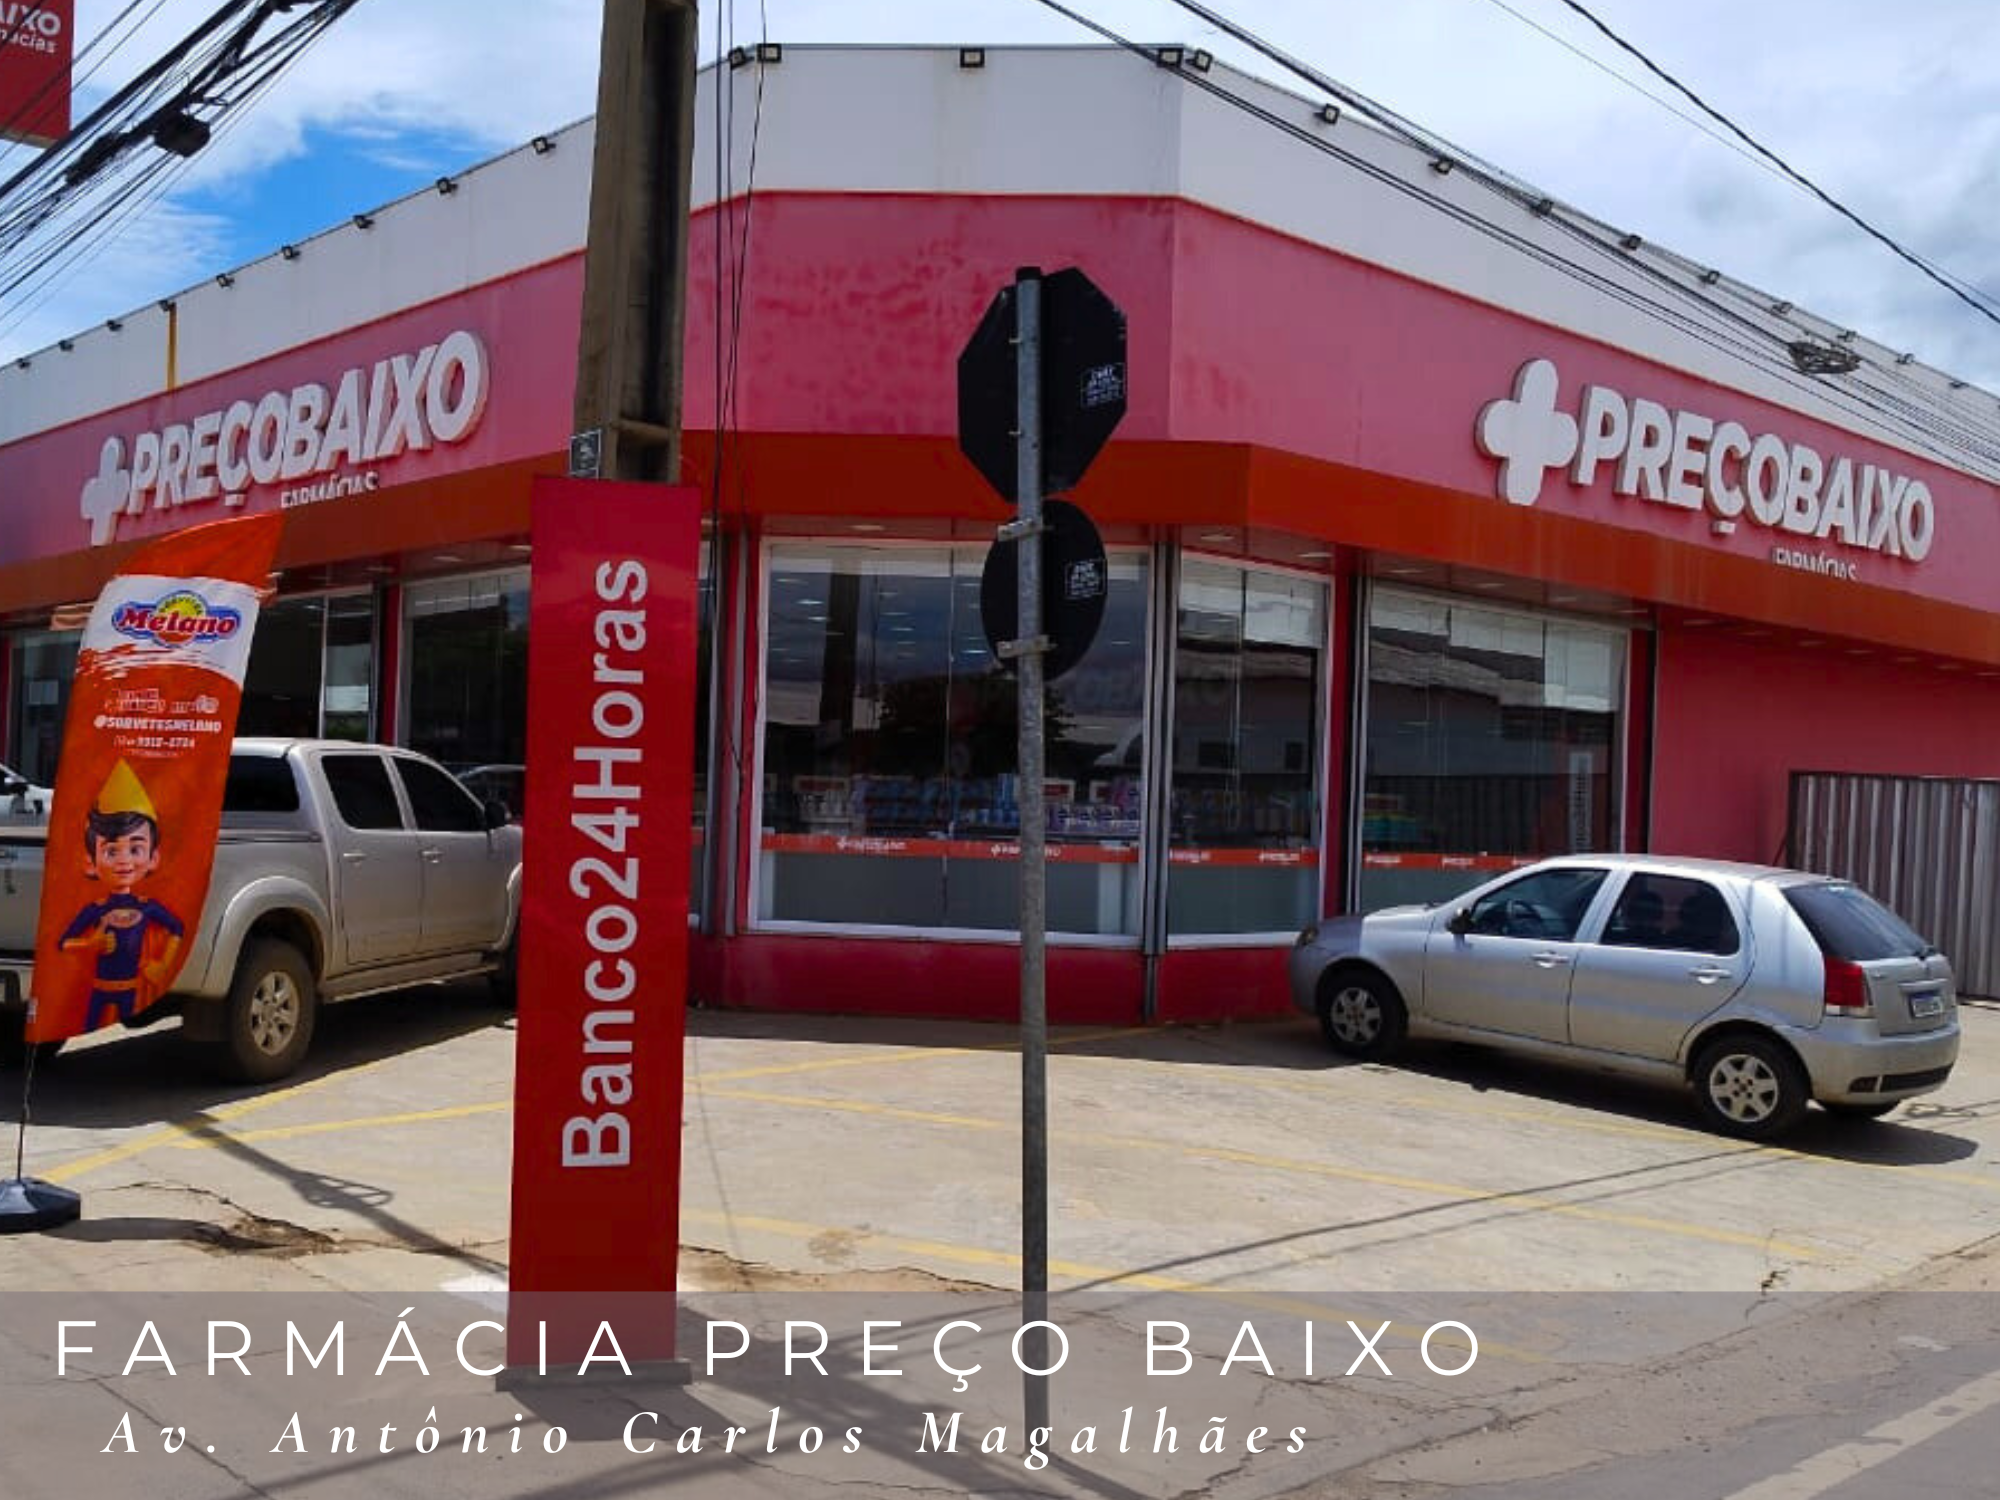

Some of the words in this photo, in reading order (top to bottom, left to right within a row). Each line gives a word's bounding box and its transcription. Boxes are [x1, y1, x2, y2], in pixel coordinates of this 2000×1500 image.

[0, 1, 61, 36] IXO
[127, 329, 490, 514] PREÇOBAIXO
[1571, 385, 1935, 563] PREÇOBAIXO
[117, 607, 237, 635] Melano
[561, 559, 649, 1168] Banco24Horas
